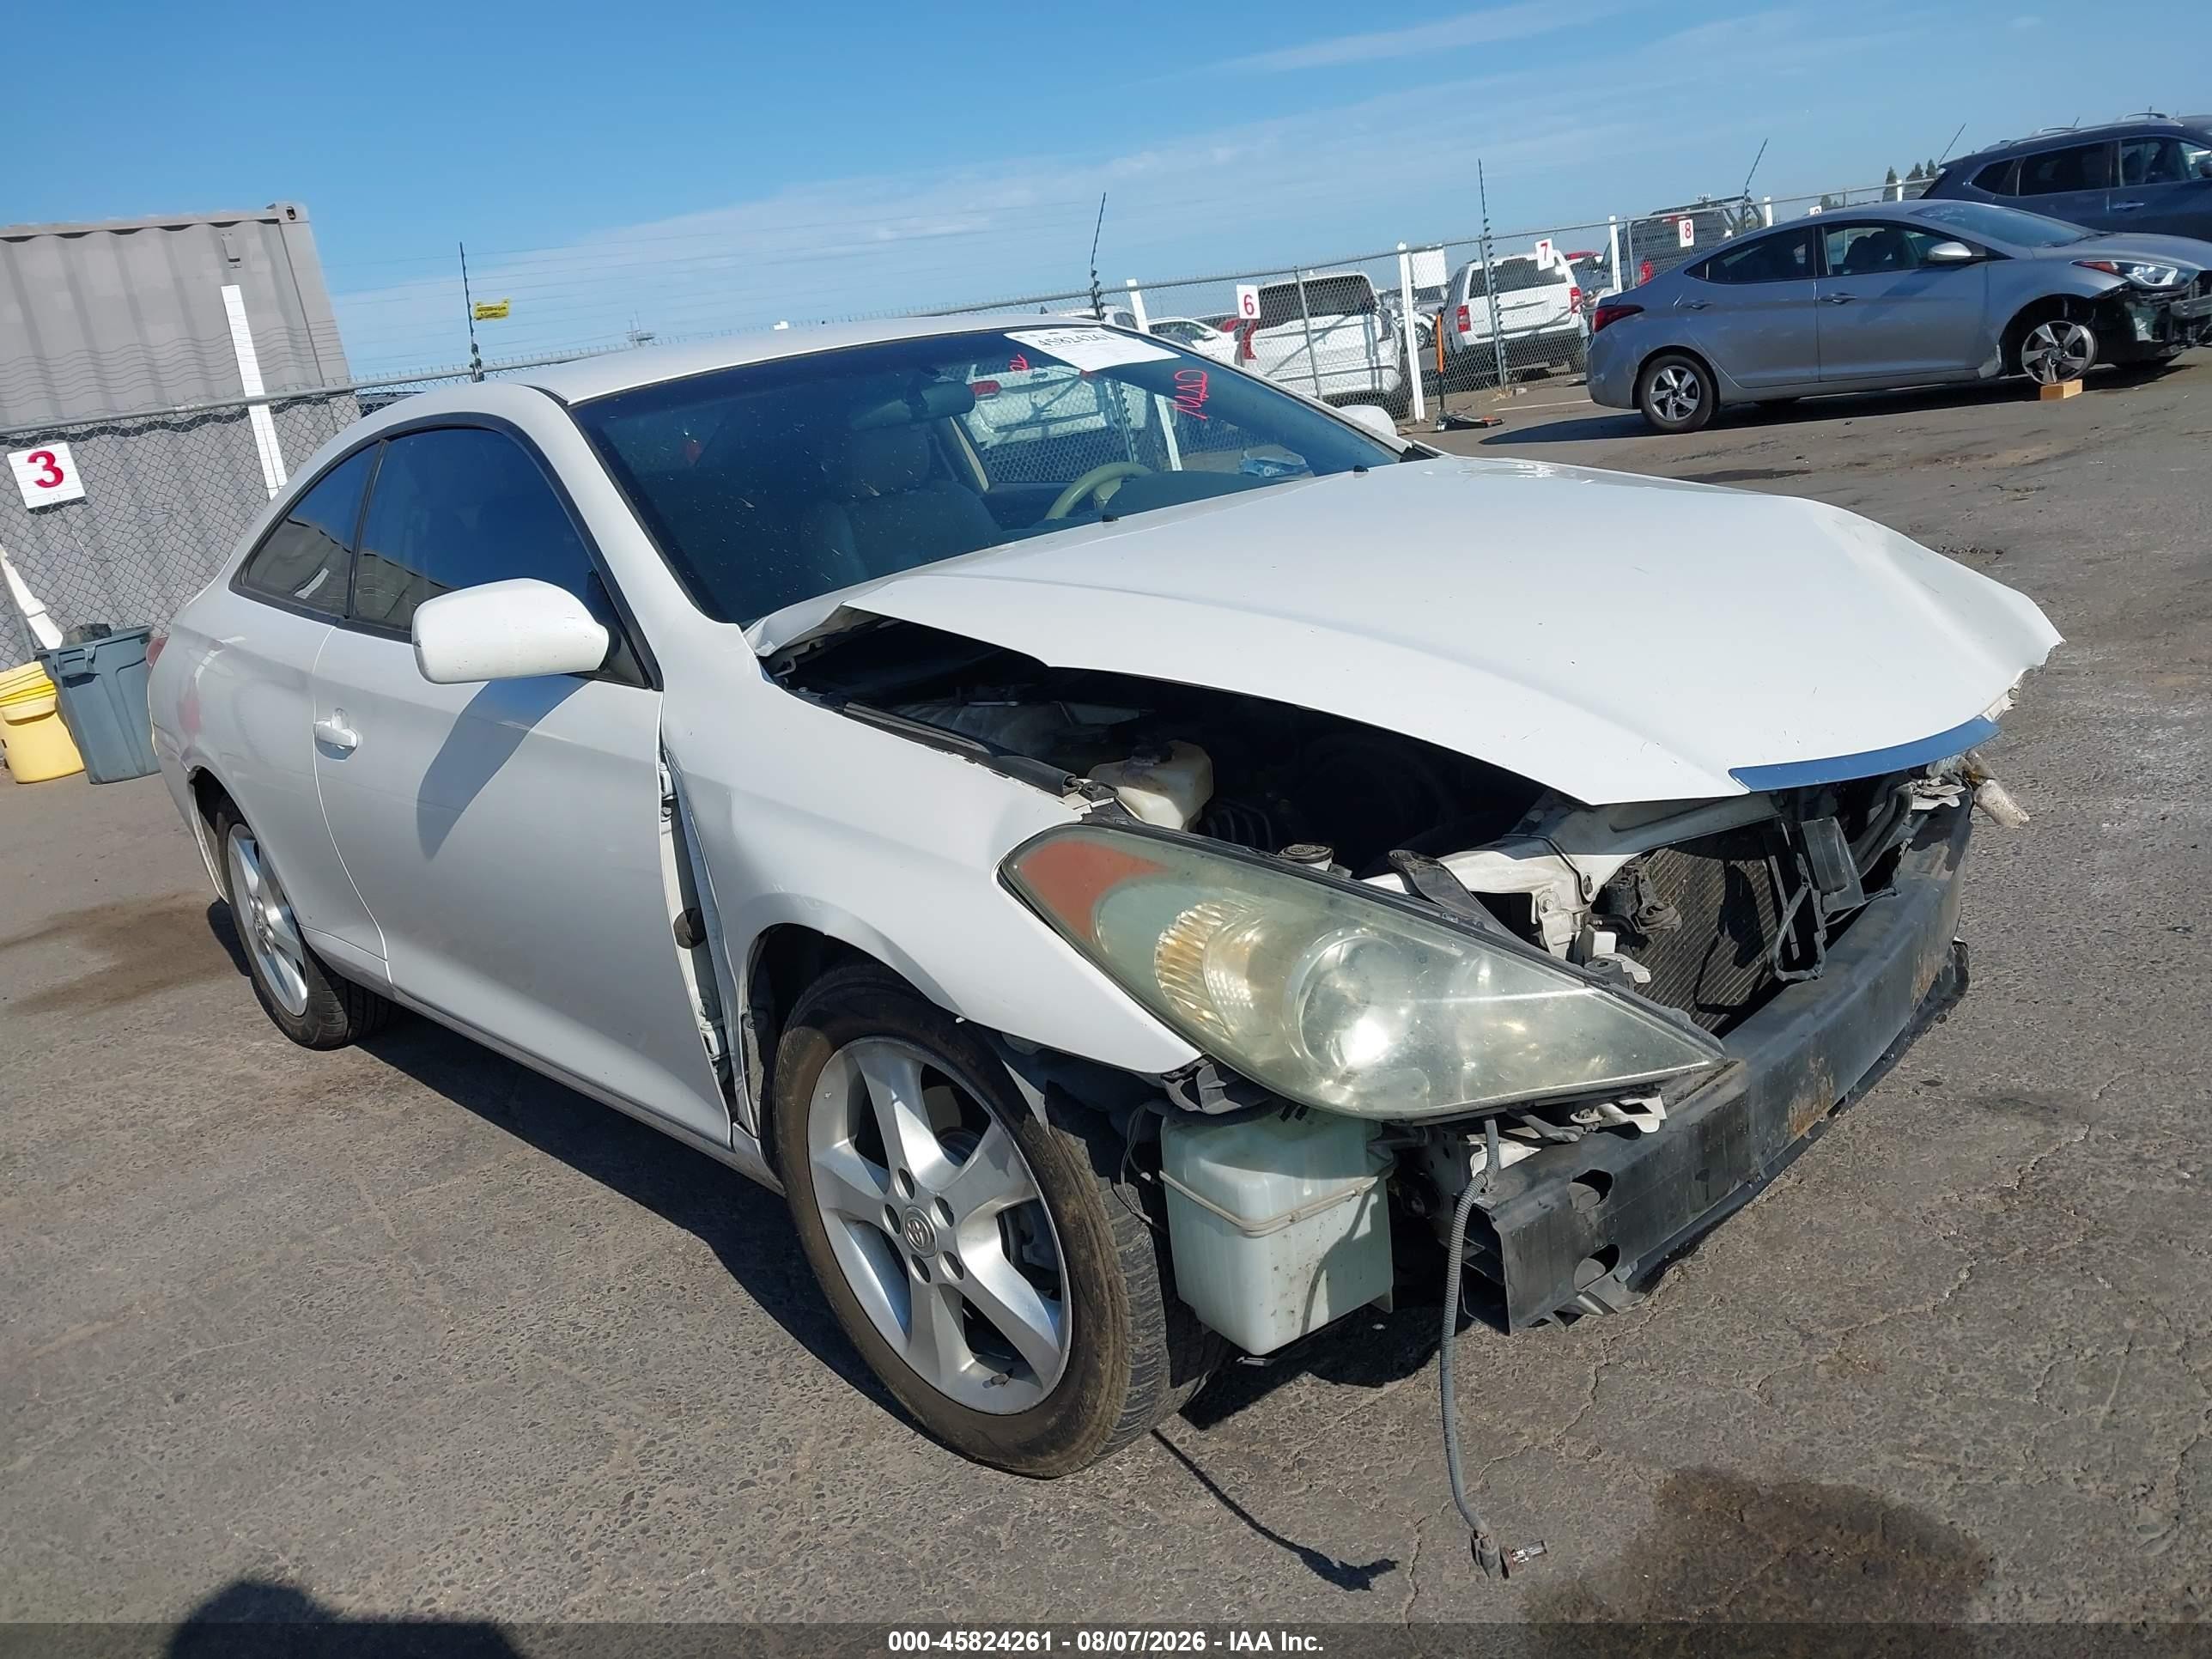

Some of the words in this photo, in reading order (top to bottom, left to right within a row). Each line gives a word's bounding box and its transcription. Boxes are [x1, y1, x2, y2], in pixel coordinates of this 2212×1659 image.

[1685, 222, 1692, 240] 8
[1540, 241, 1548, 262] 7
[1243, 294, 1255, 316] 6
[27, 450, 64, 489] 3
